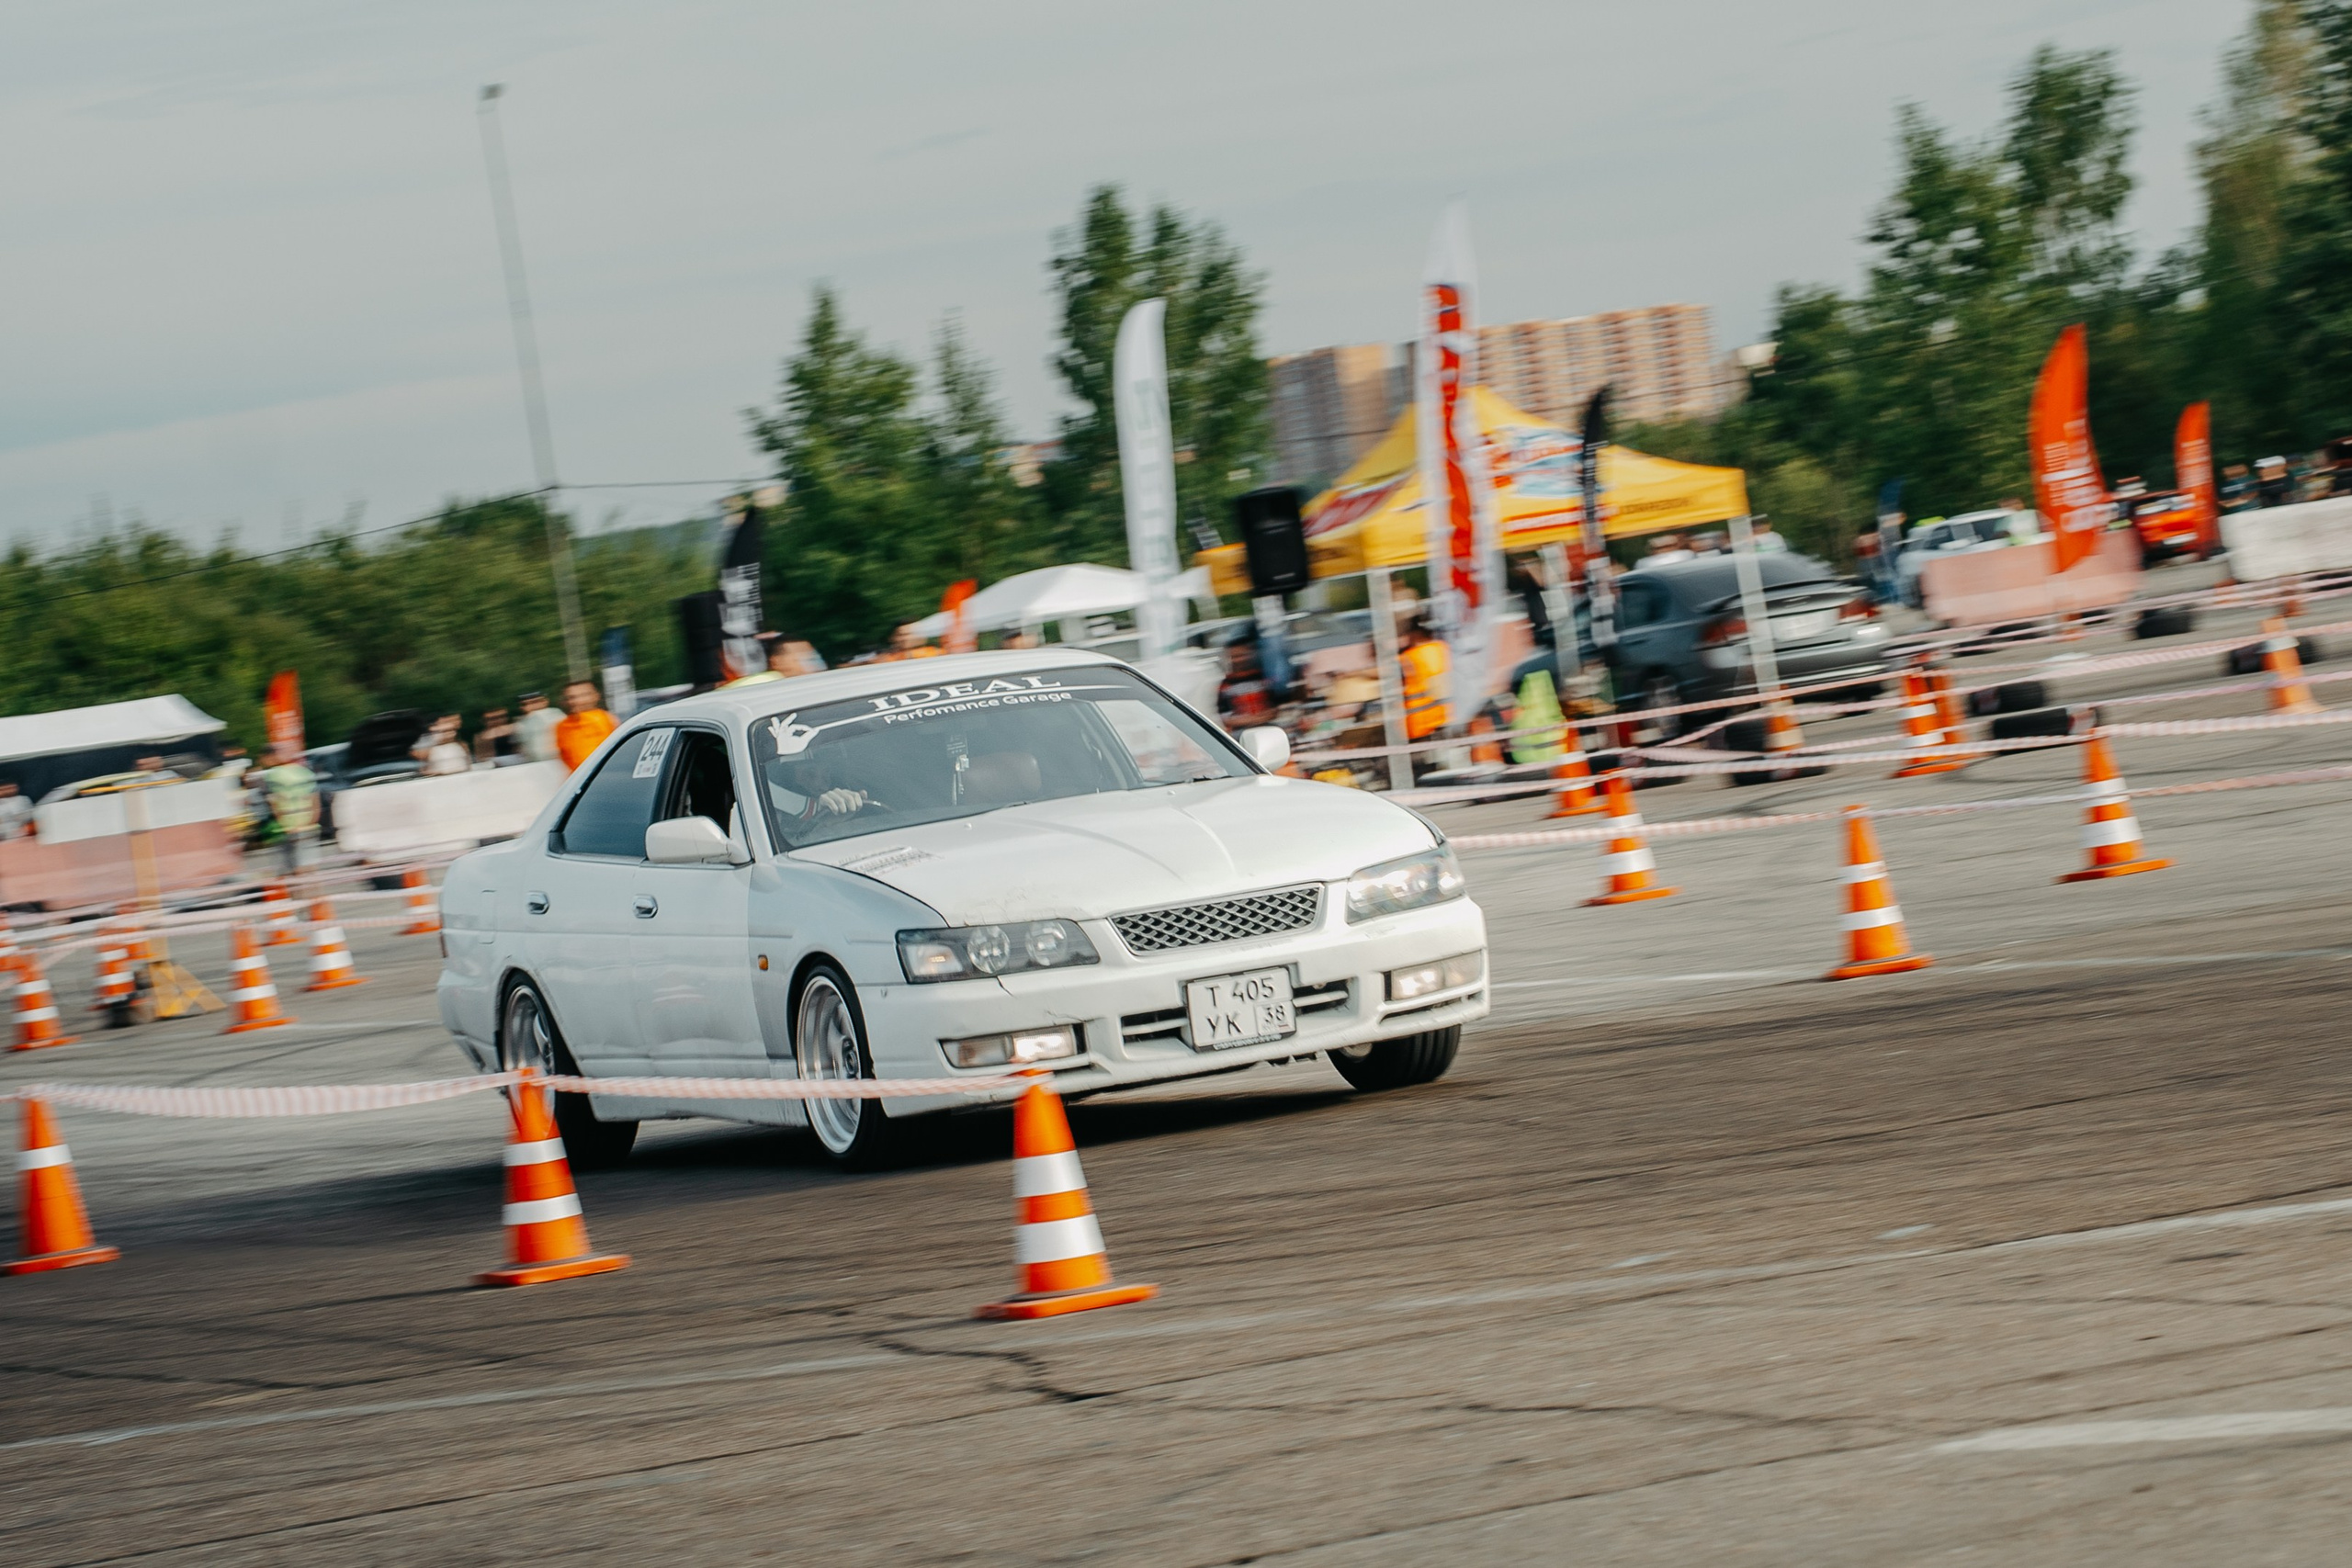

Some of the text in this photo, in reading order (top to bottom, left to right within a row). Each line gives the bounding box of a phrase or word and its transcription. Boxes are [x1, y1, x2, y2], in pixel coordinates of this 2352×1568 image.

[867, 676, 1061, 712] IDEAL
[883, 692, 1072, 725] Perfomance Garage
[640, 735, 670, 761] 244
[1233, 976, 1274, 1003] 405
[1262, 1005, 1285, 1025] 38
